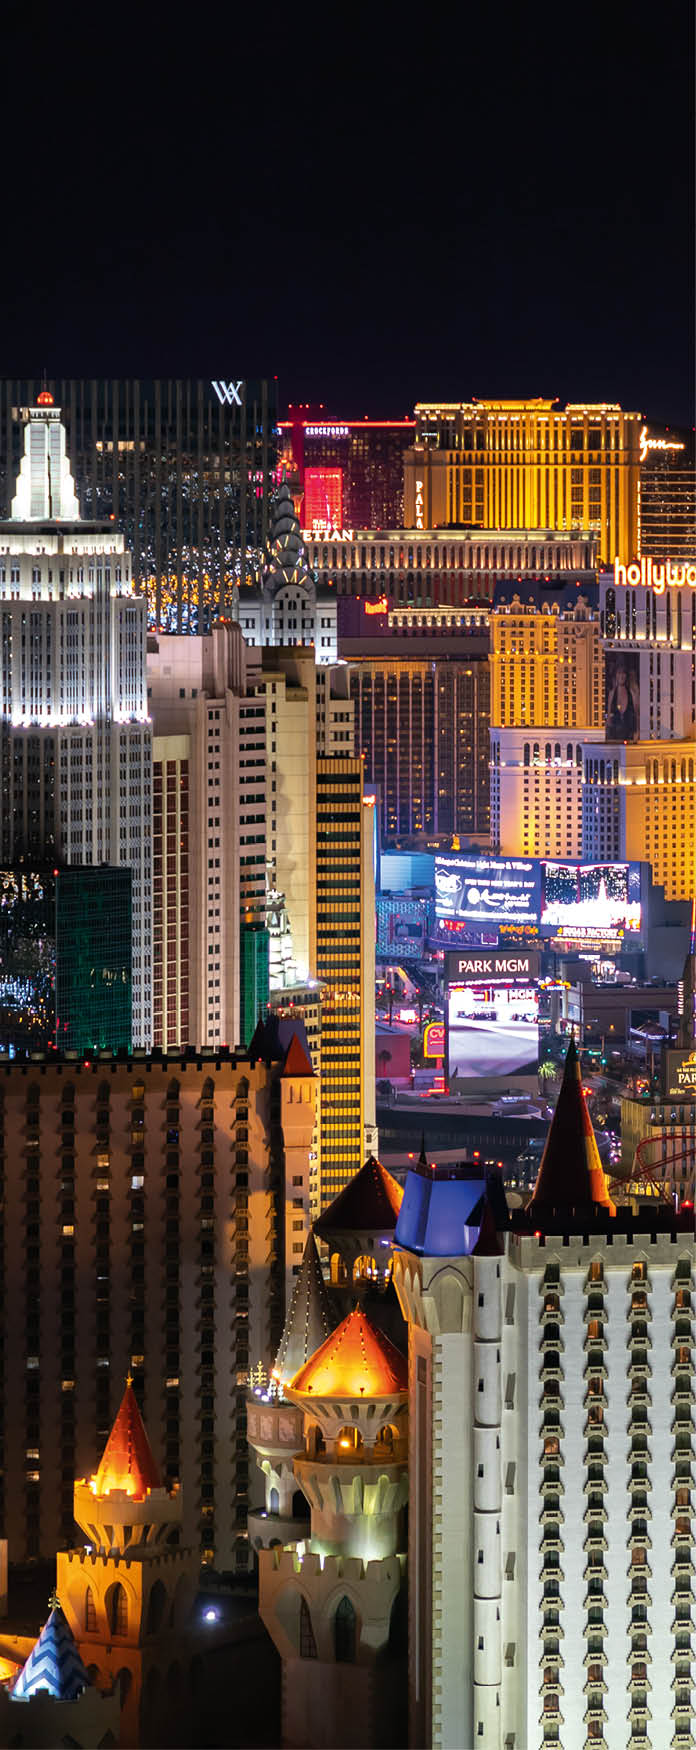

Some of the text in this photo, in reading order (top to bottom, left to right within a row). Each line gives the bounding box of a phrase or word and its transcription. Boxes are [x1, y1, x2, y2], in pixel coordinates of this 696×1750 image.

[305, 427, 349, 435] CROCKFORDS
[300, 529, 354, 542] ETIAN
[458, 959, 529, 973] PARK MGM
